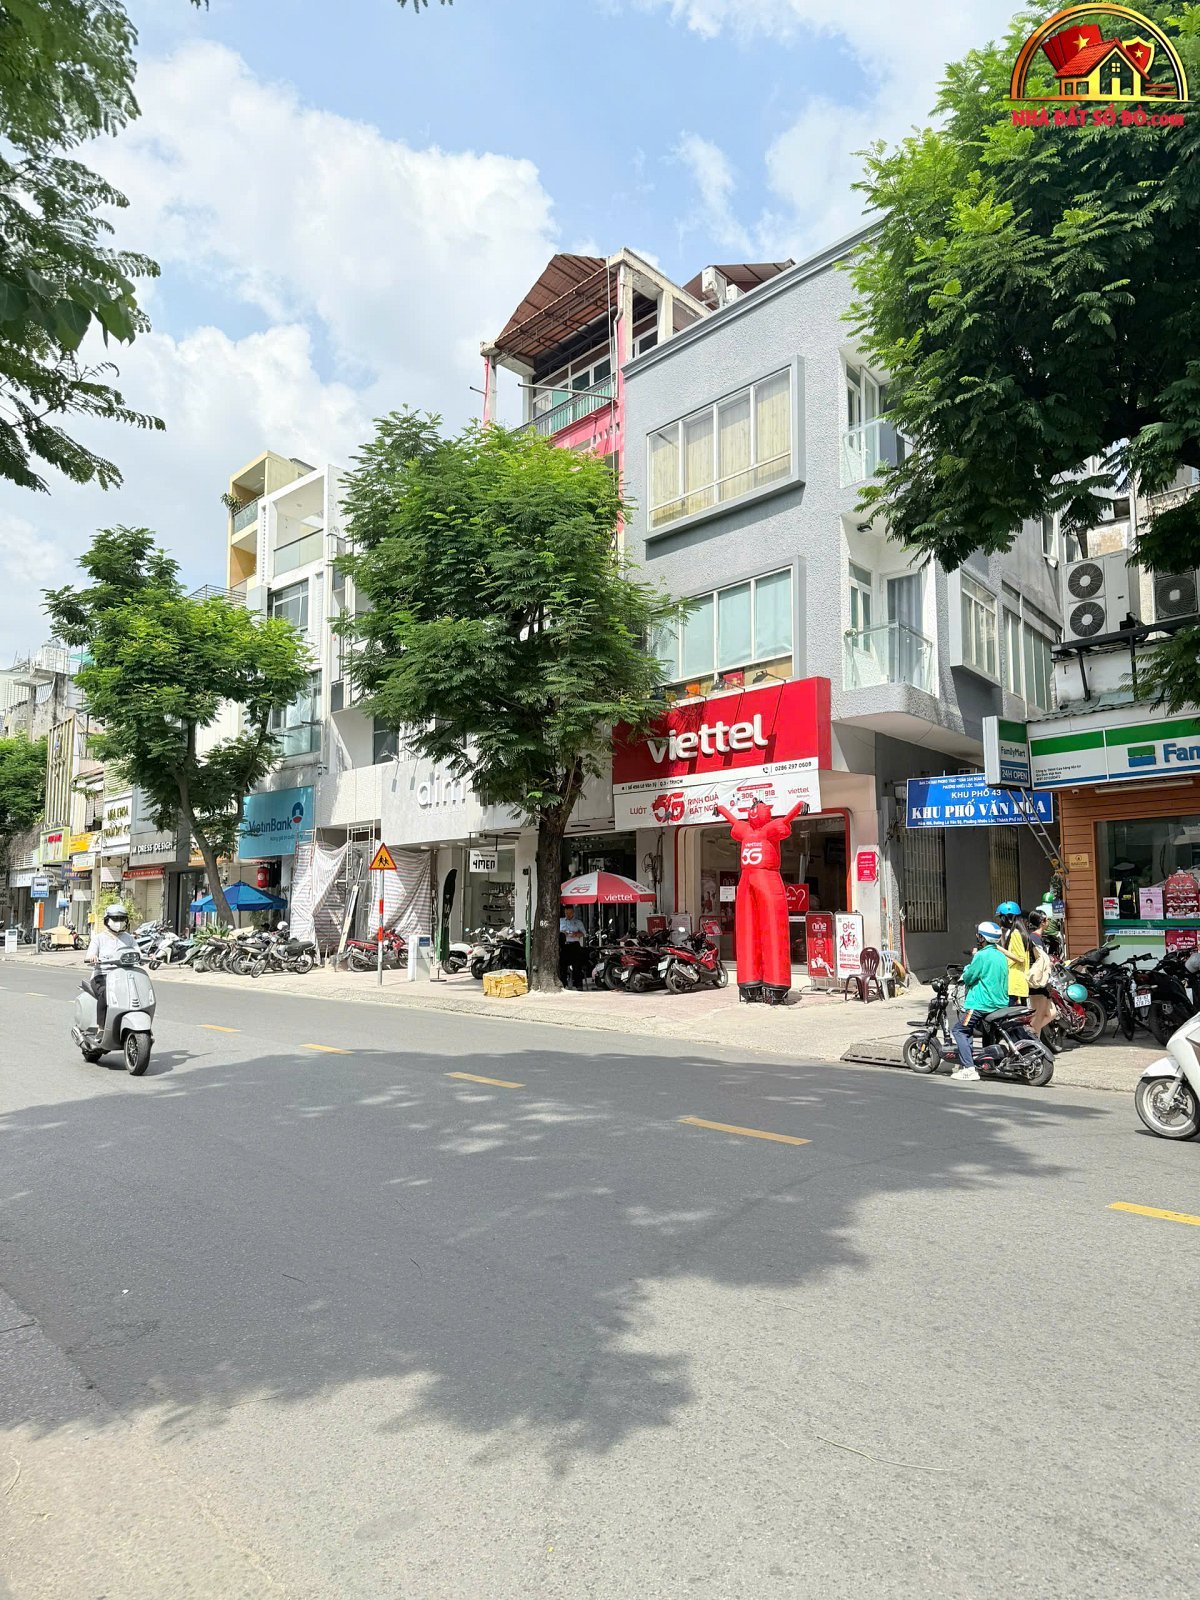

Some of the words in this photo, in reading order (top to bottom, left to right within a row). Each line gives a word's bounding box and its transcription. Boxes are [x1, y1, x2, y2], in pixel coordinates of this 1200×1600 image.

[647, 713, 768, 764] viettel
[1001, 769, 1013, 779] 24H
[1013, 771, 1028, 781] OPEN
[787, 786, 810, 795] viettel
[951, 791, 970, 799] KHU
[971, 787, 990, 798] PHỐ
[912, 806, 941, 820] KHU
[944, 798, 976, 818] PHỐ
[979, 799, 1010, 816] VĂN
[741, 847, 763, 865] 5G
[604, 893, 633, 901] viettel
